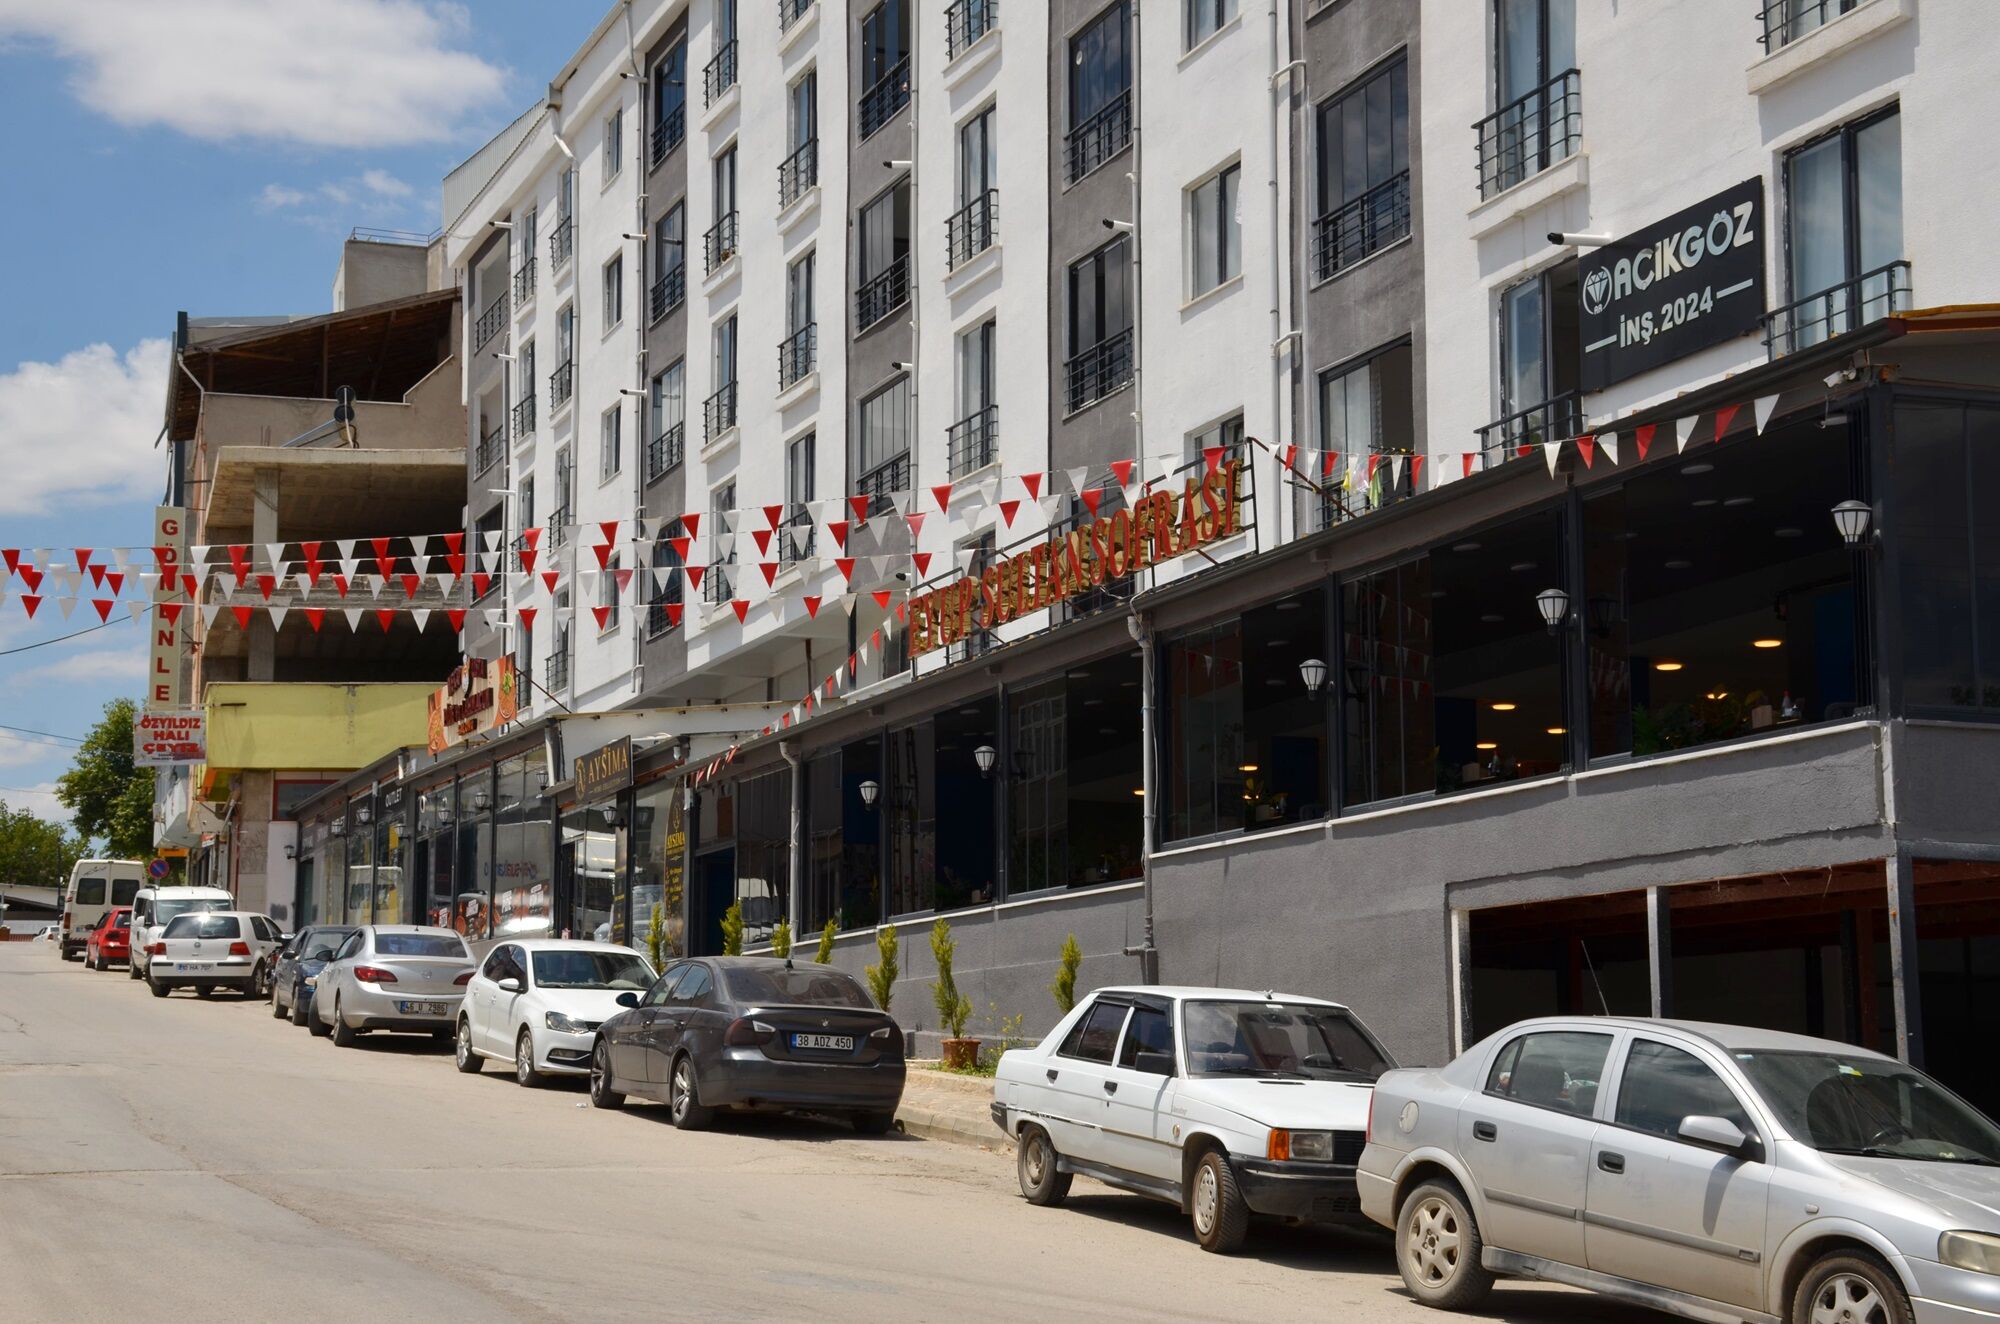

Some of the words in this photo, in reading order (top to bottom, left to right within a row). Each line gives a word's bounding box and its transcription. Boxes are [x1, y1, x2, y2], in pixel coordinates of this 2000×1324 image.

[1613, 201, 1754, 301] AÇIKGÖZ
[1660, 286, 1713, 332] 2024
[141, 715, 201, 729] ÖZYILDIZ
[153, 730, 190, 741] HALI
[797, 1035, 809, 1047] 38
[834, 1037, 852, 1049] 450
